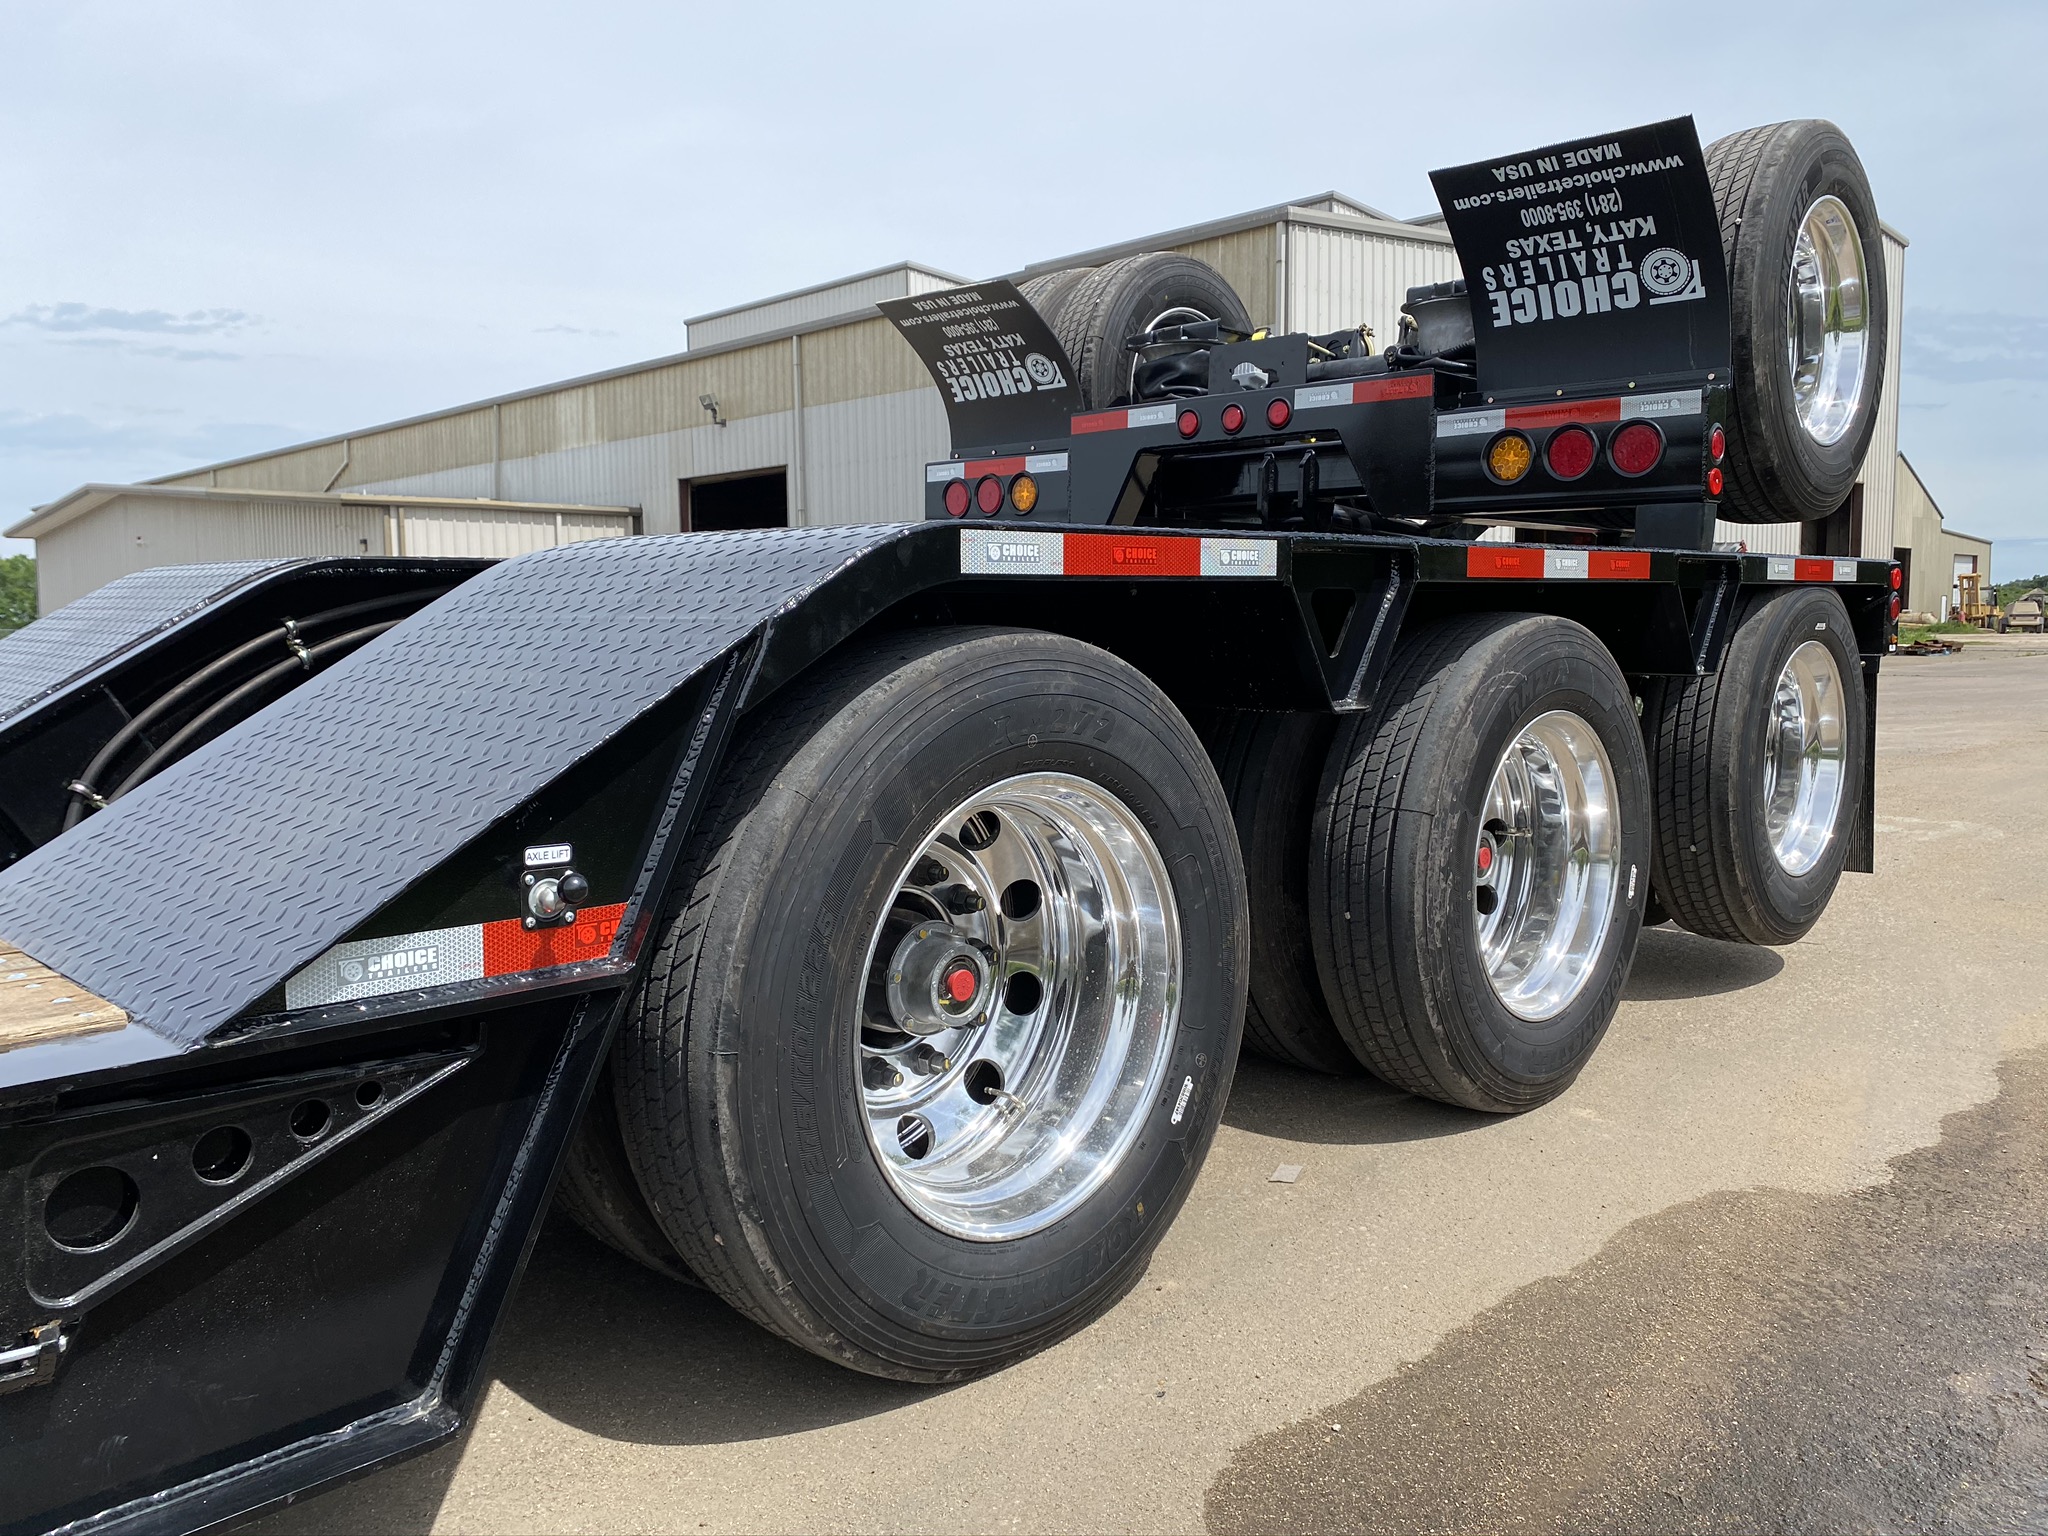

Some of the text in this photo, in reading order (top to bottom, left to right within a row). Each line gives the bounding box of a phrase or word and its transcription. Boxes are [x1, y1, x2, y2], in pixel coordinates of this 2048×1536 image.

[1491, 142, 1623, 182] MADE IN USA
[1453, 154, 1684, 211] www.choicetrailers.com
[1520, 187, 1623, 228] (281) 395-8000
[1505, 215, 1657, 259] KATY, TEXAS
[1482, 243, 1633, 291] TRAILERS
[912, 291, 983, 312] MADE IN USA
[1488, 270, 1641, 328] CHOICE
[899, 299, 1020, 327] www.choicetrailers.com
[943, 333, 1026, 357] KATY, TEXAS
[936, 349, 1022, 378] TRAILERS
[945, 366, 1033, 403] CHOICE
[1640, 402, 1669, 412] CHOICE
[1002, 544, 1039, 557] CHOICE
[1126, 548, 1157, 559] CHOICE
[1231, 550, 1259, 561] CHOICE
[527, 848, 570, 862] AXLE LIFT
[367, 947, 438, 972] CHOICE
[367, 962, 438, 979] TRAILERS
